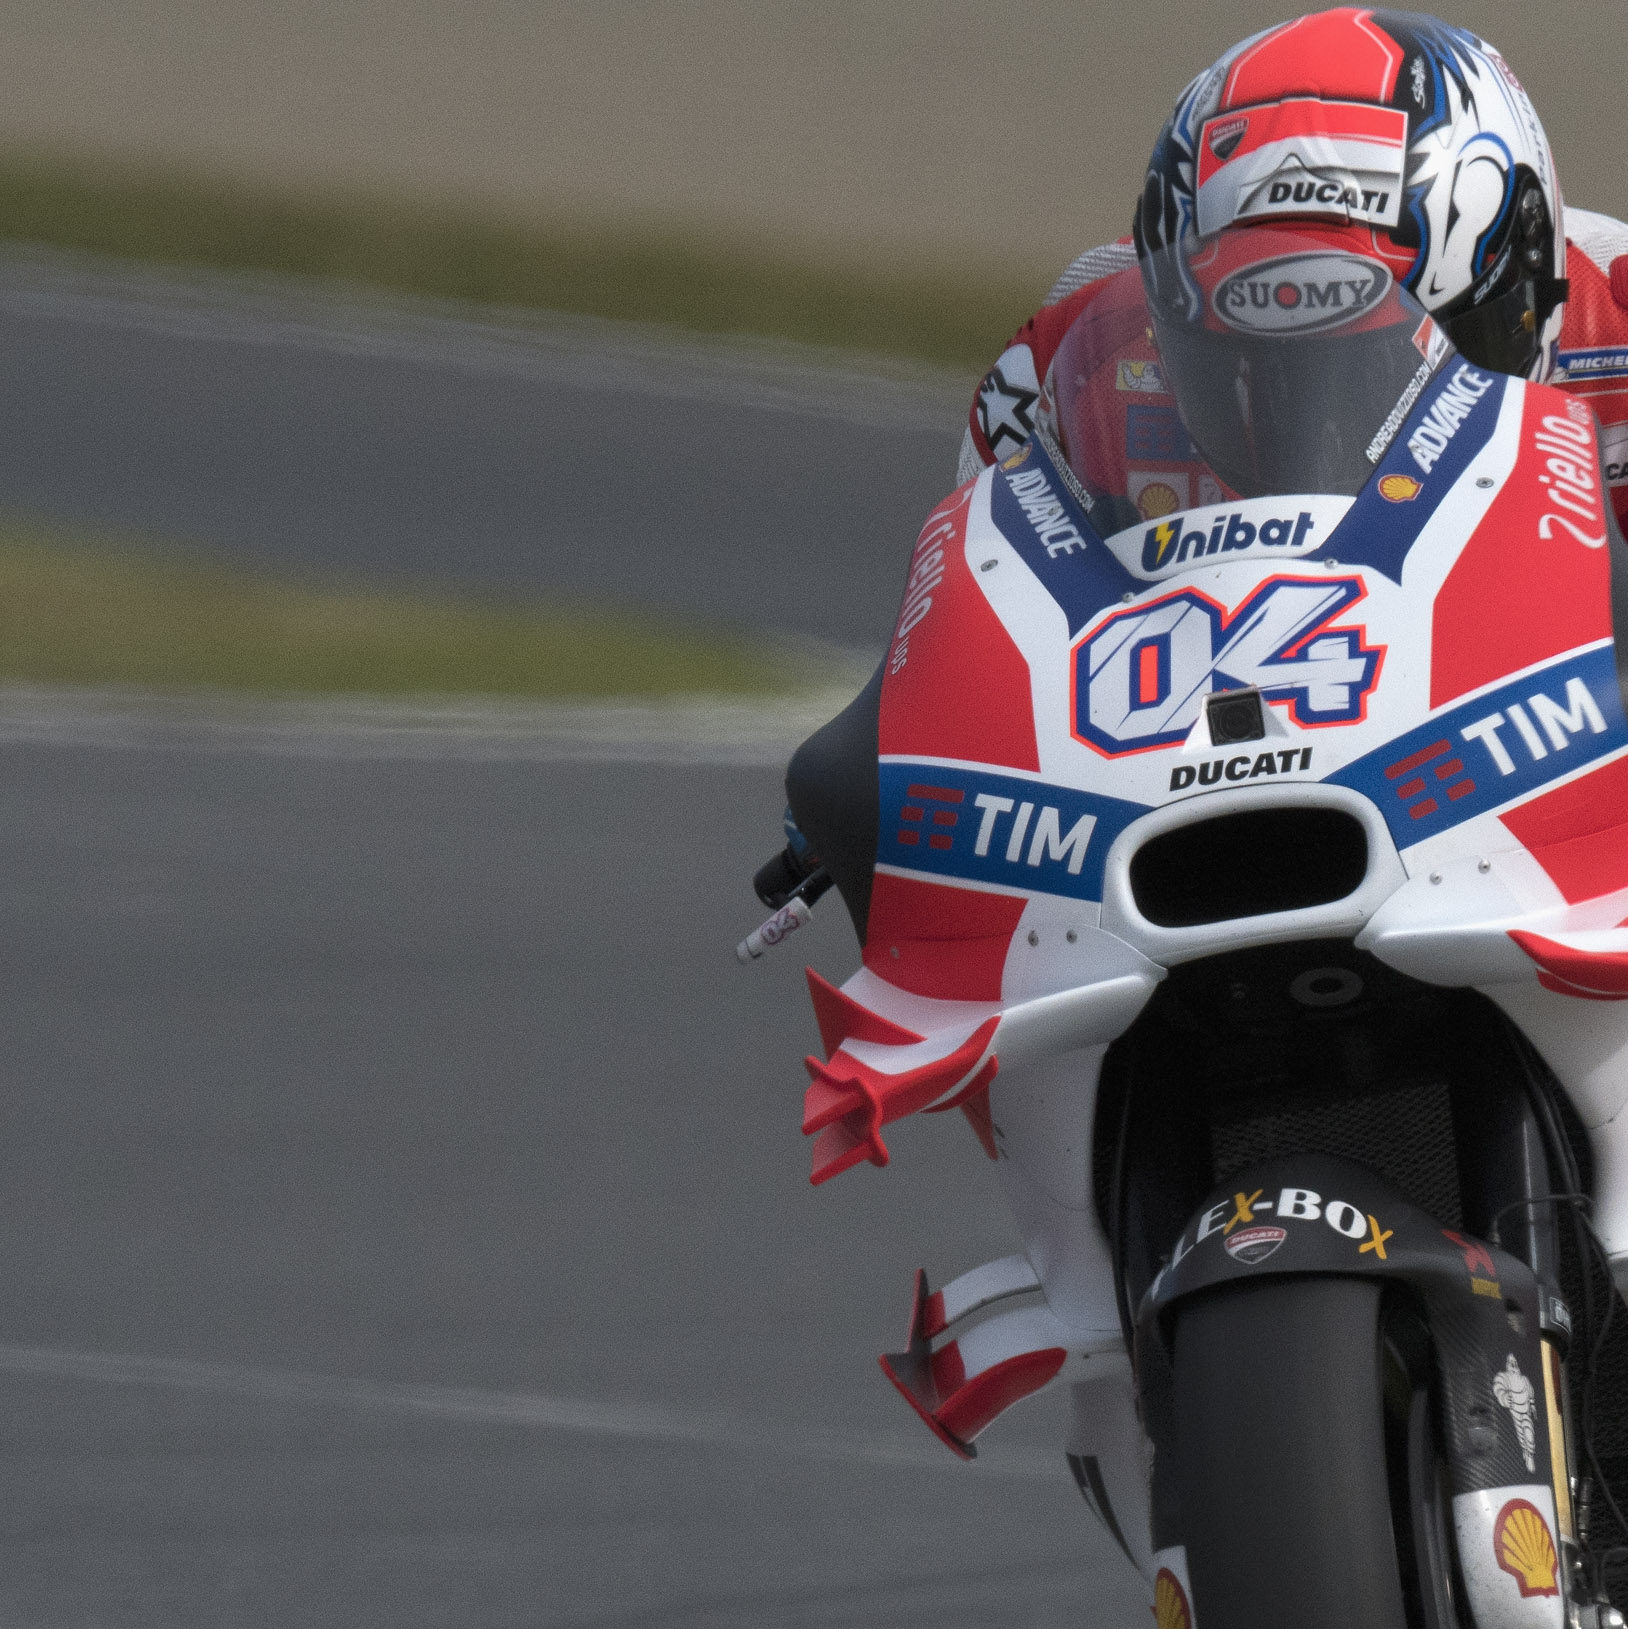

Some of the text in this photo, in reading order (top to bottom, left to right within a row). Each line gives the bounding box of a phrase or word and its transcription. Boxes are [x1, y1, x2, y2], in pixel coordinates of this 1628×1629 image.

[1267, 181, 1389, 214] DUCATI
[1227, 278, 1373, 310] SUOMY
[1407, 363, 1494, 475] ADVANCE
[1005, 467, 1088, 559] ADVANCE
[1142, 511, 1315, 573] Unibat
[1070, 573, 1388, 760] 04
[1461, 677, 1609, 777] TIM
[1169, 747, 1313, 792] DUCATI
[974, 793, 1098, 876] TIM
[1230, 1229, 1281, 1244] DUCATI
